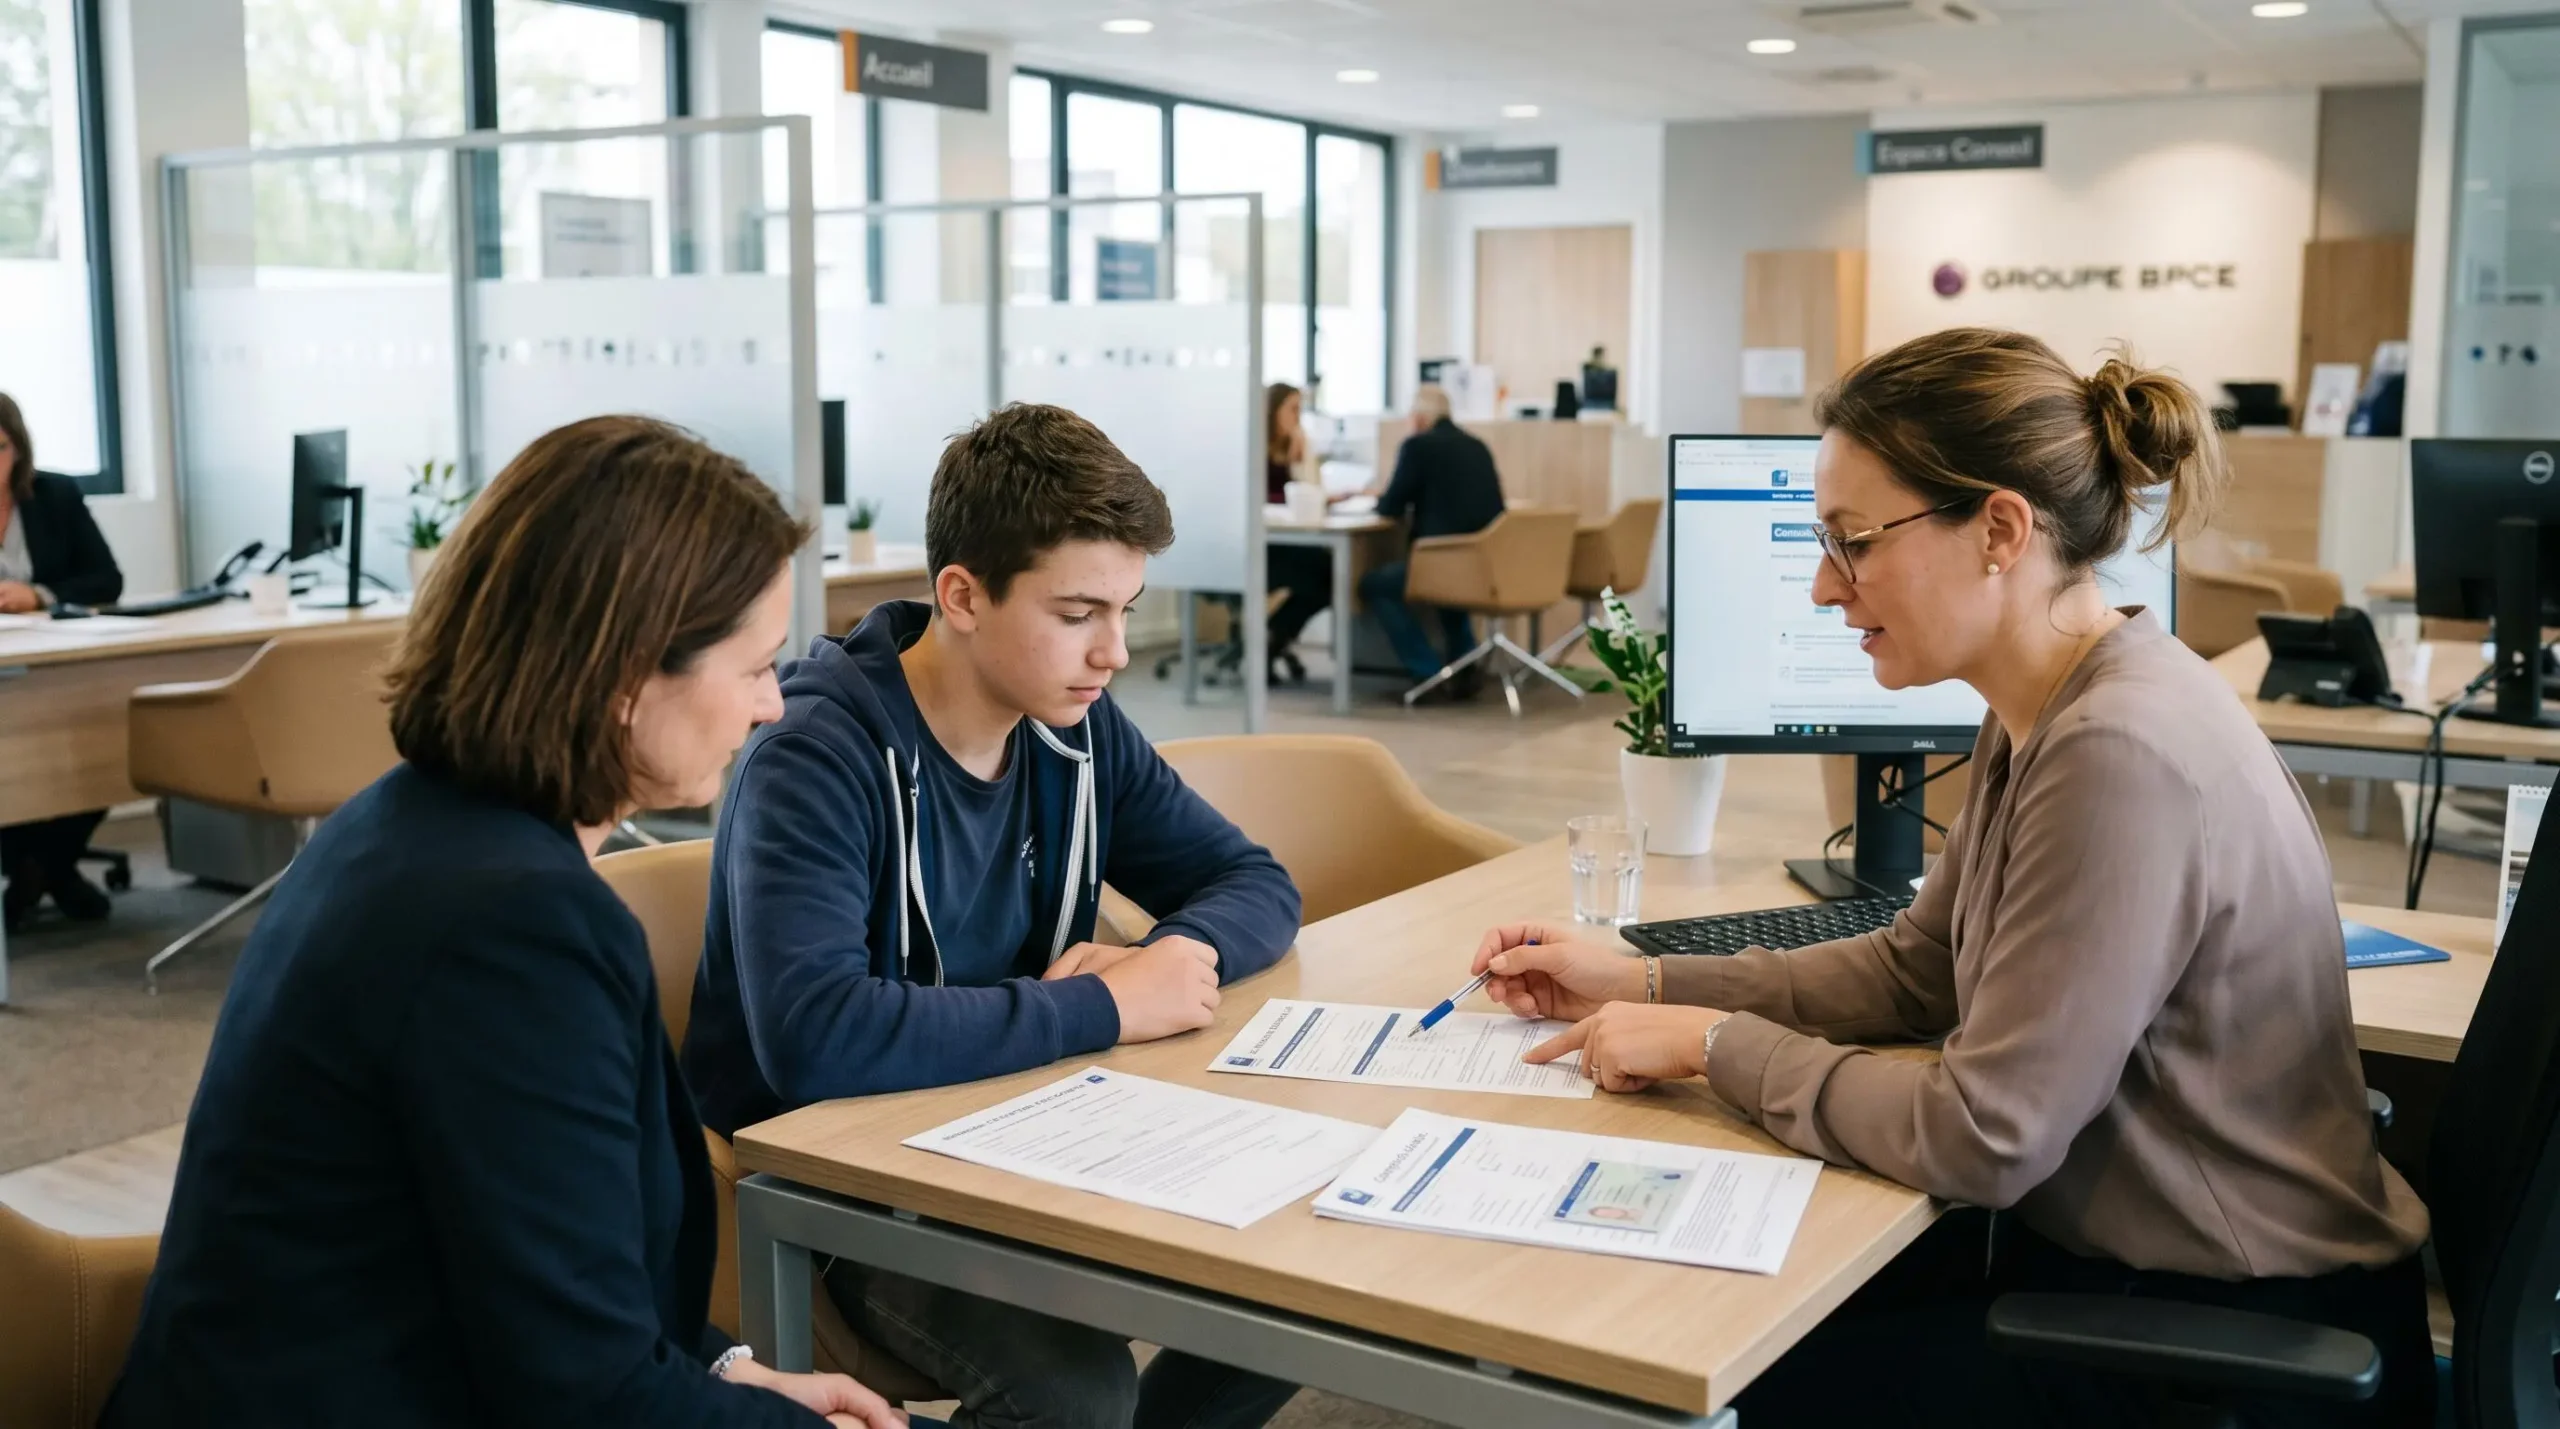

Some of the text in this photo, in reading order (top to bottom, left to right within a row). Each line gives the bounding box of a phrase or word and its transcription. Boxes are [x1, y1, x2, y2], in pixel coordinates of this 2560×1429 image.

[863, 51, 934, 88] Accueil
[1981, 265, 2236, 291] GROUPE BPCE
